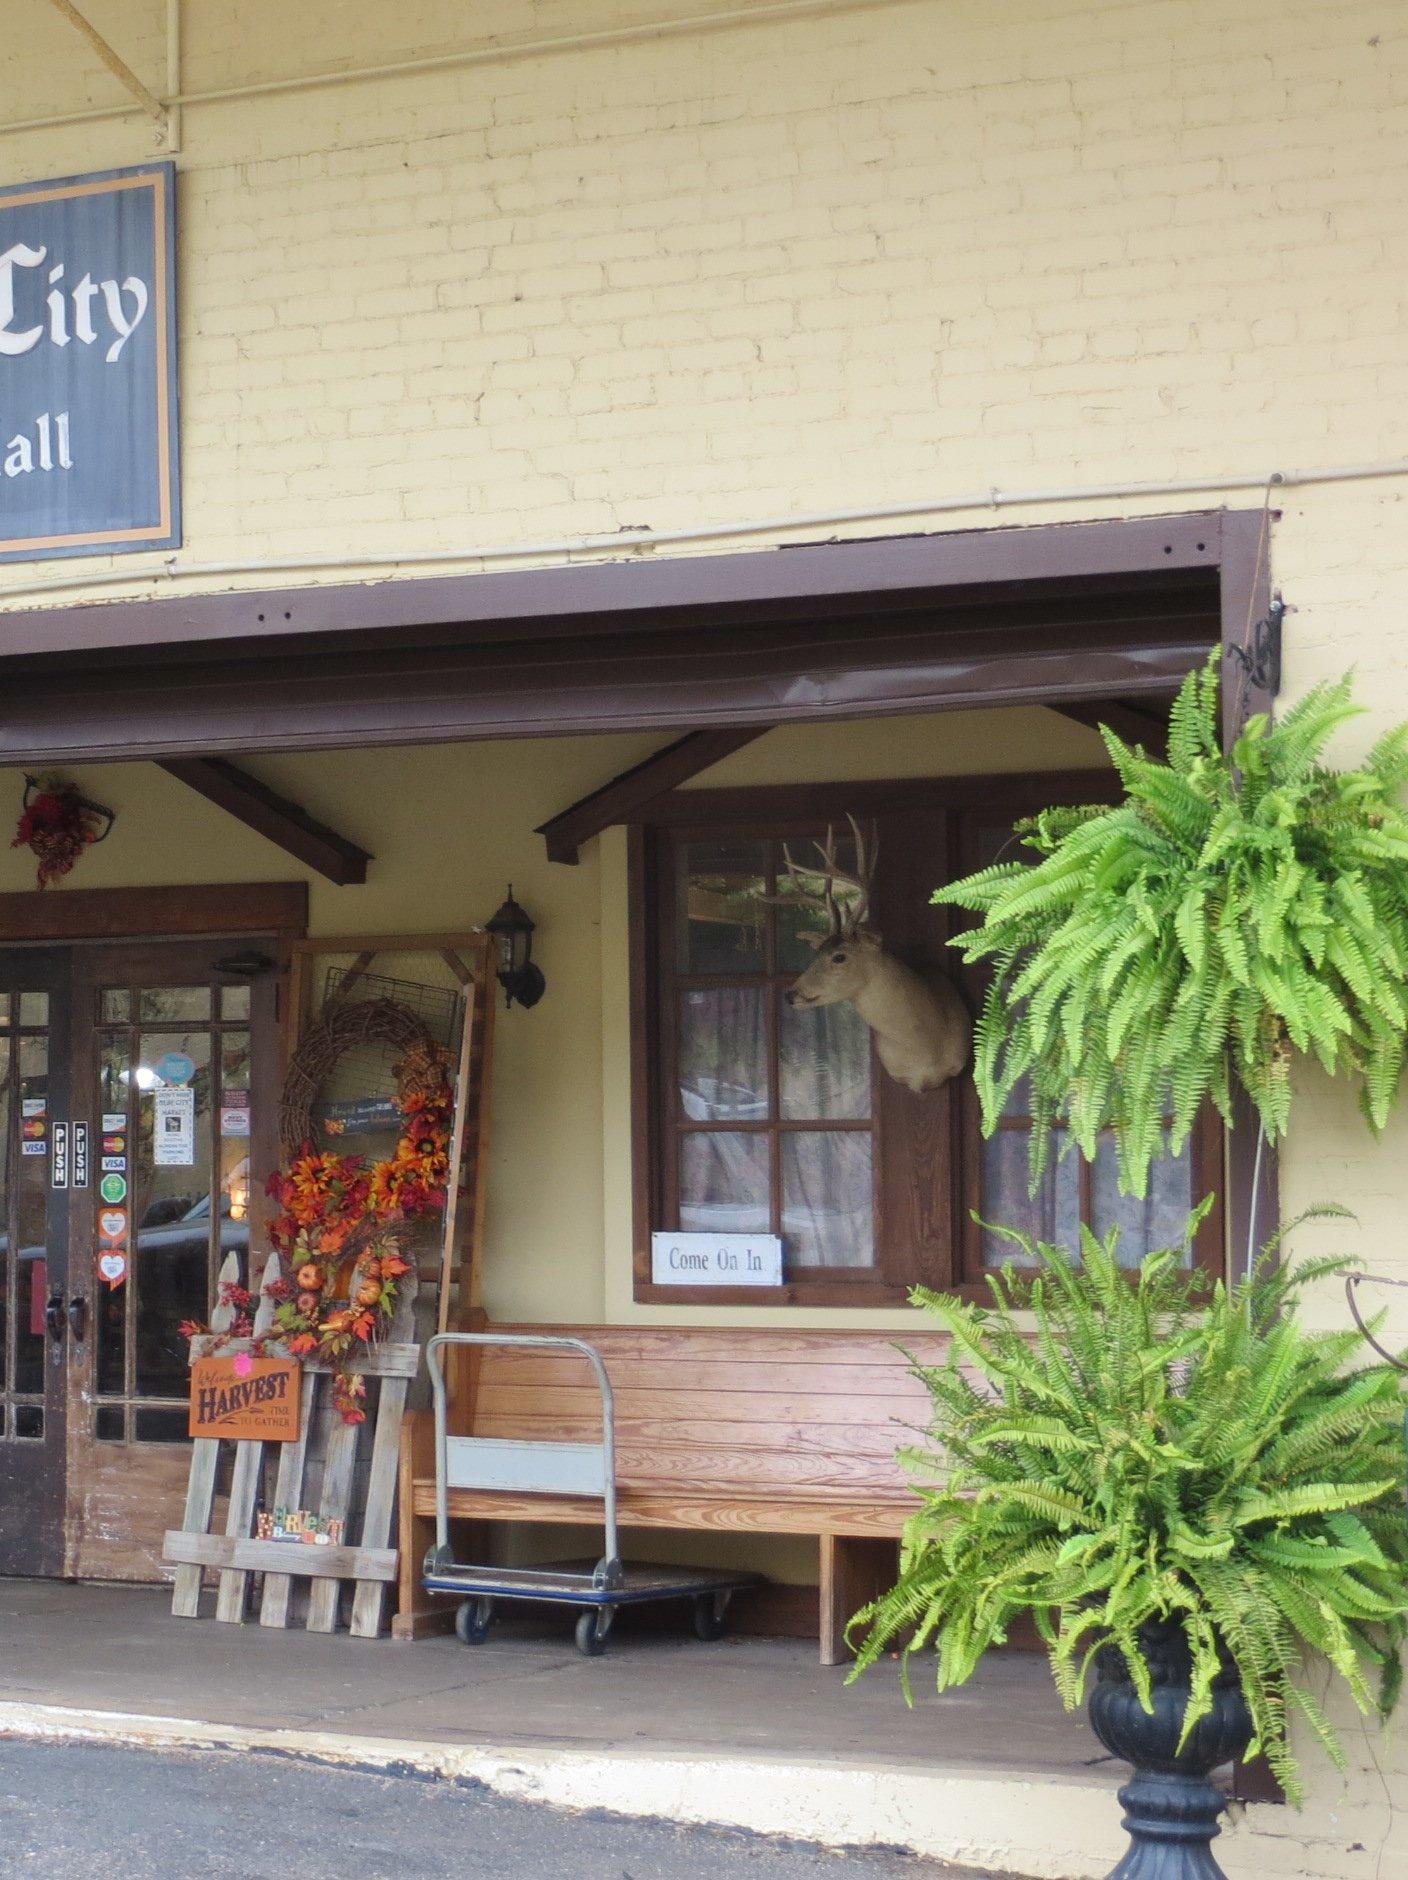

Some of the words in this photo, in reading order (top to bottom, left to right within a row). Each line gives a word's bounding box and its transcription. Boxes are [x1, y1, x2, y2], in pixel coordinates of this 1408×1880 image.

[25, 1143, 45, 1153] VISA
[55, 1128, 65, 1182] PUSH
[76, 1127, 85, 1181] PUSH
[105, 1159, 125, 1168] VISA
[669, 1247, 709, 1271] Come
[717, 1248, 738, 1271] On
[747, 1249, 762, 1271] In
[197, 1371, 290, 1424] HARVEST
